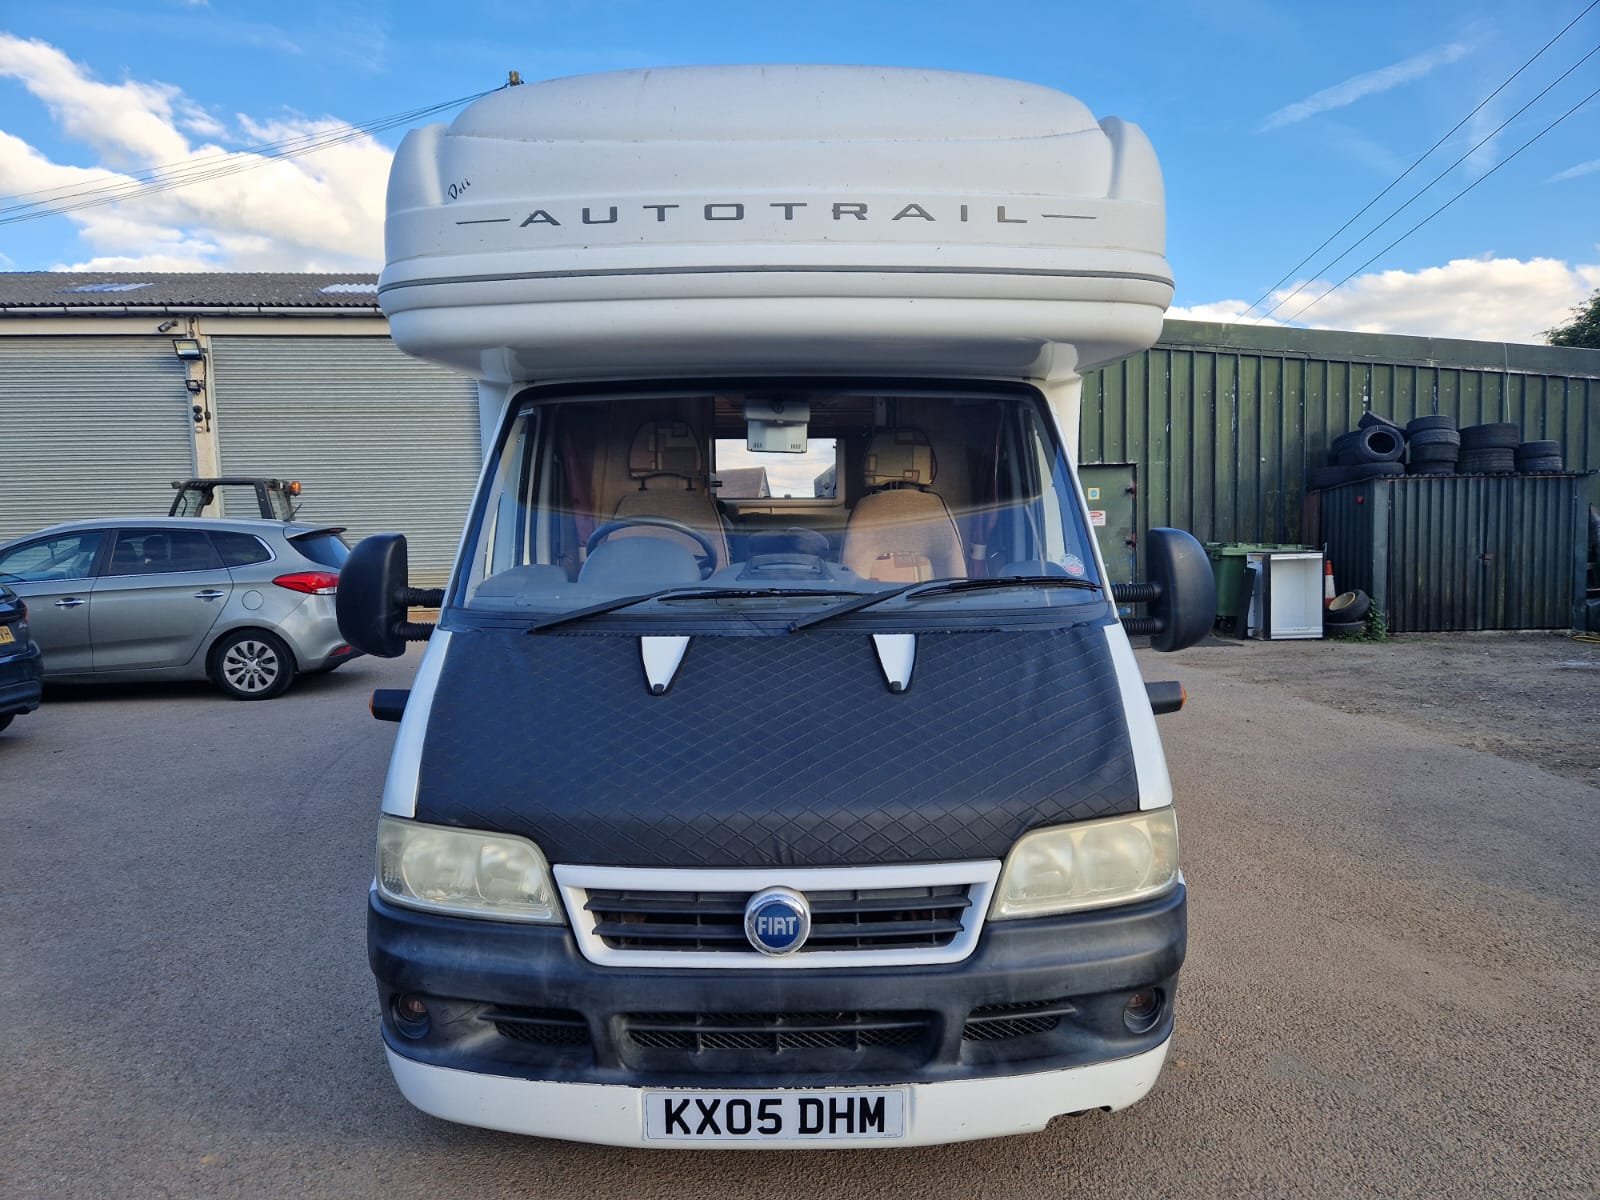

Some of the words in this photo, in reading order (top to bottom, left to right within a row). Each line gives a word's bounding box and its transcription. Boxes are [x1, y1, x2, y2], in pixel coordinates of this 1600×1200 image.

[519, 203, 1028, 227] AUTOTRAIL
[757, 916, 797, 936] FIAT
[664, 1098, 782, 1135] KX05
[798, 1096, 885, 1134] DHM
